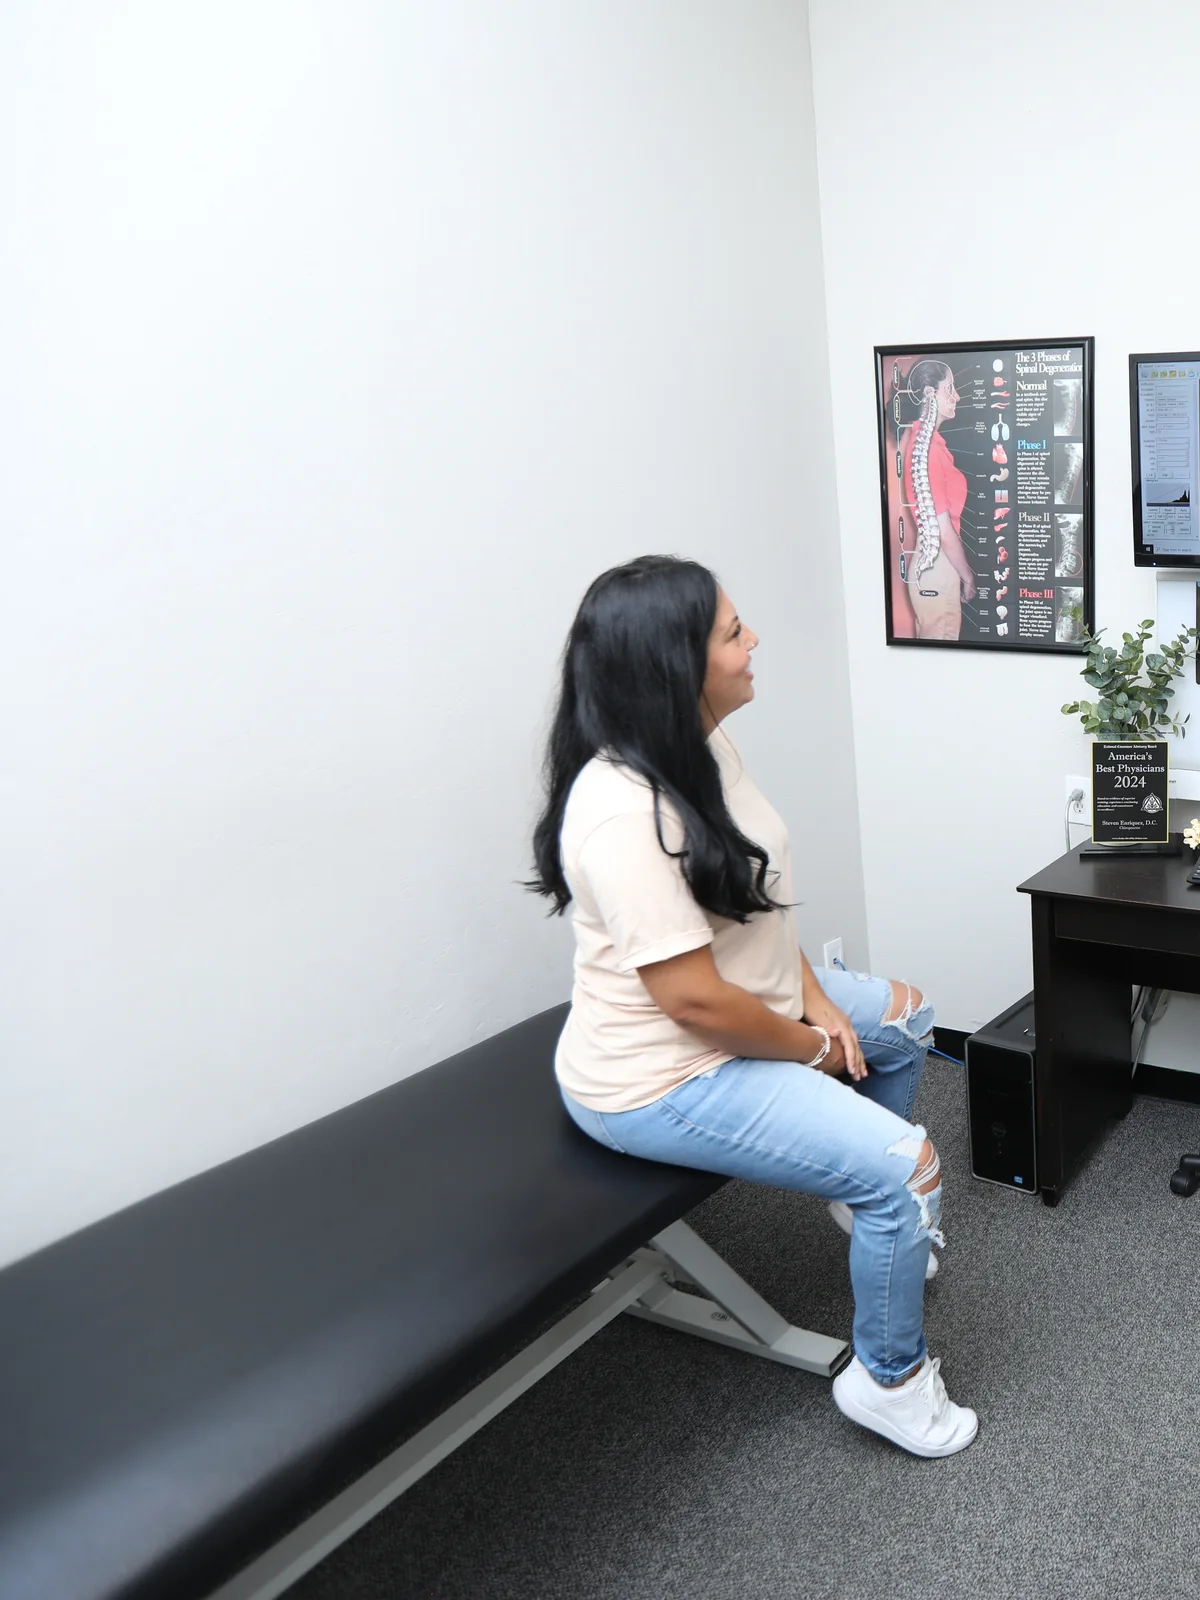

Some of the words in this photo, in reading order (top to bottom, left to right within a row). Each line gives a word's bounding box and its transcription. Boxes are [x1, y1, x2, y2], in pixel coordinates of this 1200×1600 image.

[1015, 352, 1030, 362] The
[1031, 352, 1036, 362] 3
[1038, 351, 1061, 361] Phases
[1063, 350, 1071, 360] of
[1016, 363, 1037, 376] Spinal
[1017, 380, 1047, 390] Normal
[1018, 440, 1041, 449] Phase
[1043, 440, 1046, 449] I
[1019, 512, 1042, 522] Phase
[1044, 513, 1050, 521] II
[1019, 588, 1042, 598] Phase
[1044, 589, 1054, 598] III
[1108, 752, 1153, 760] America's
[1096, 764, 1115, 772] Best
[1118, 764, 1165, 774] Physicians
[1114, 776, 1146, 788] 2024
